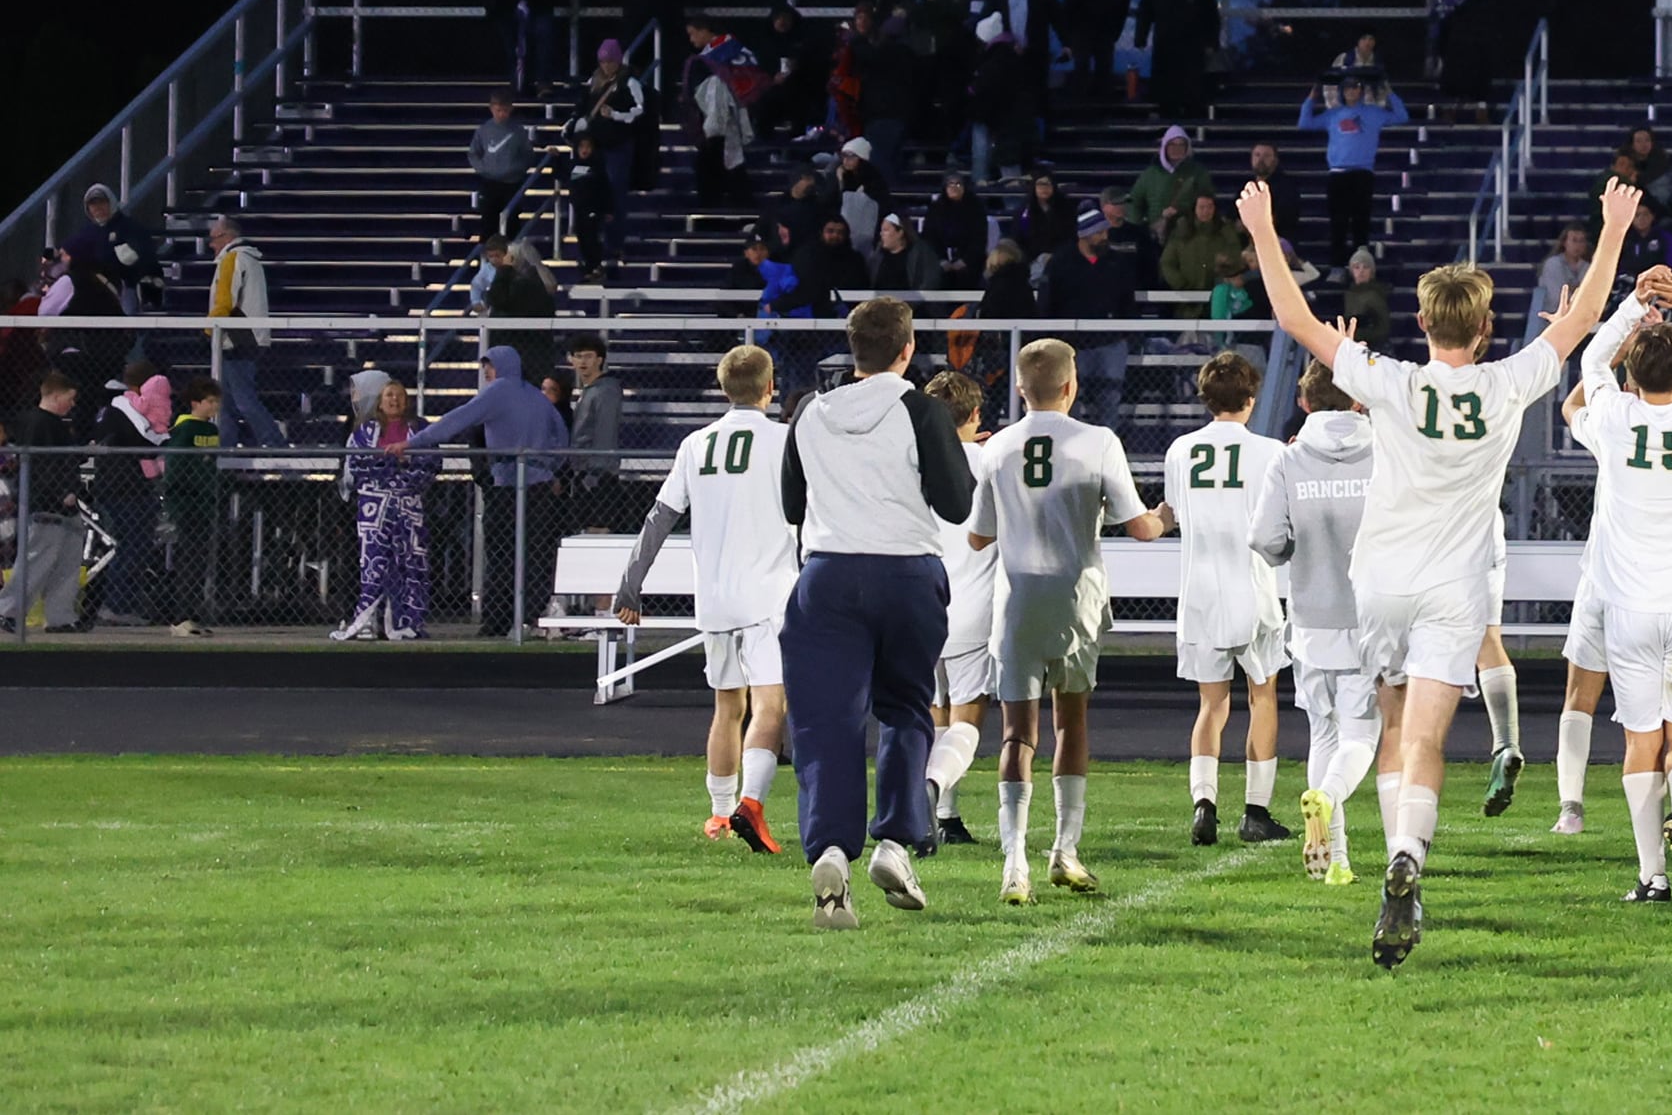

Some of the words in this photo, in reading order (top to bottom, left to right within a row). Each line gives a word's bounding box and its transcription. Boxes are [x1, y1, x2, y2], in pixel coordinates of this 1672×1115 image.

[1417, 384, 1487, 441] 13
[698, 430, 754, 476] 10
[1022, 435, 1054, 489] 8
[1190, 443, 1244, 489] 21
